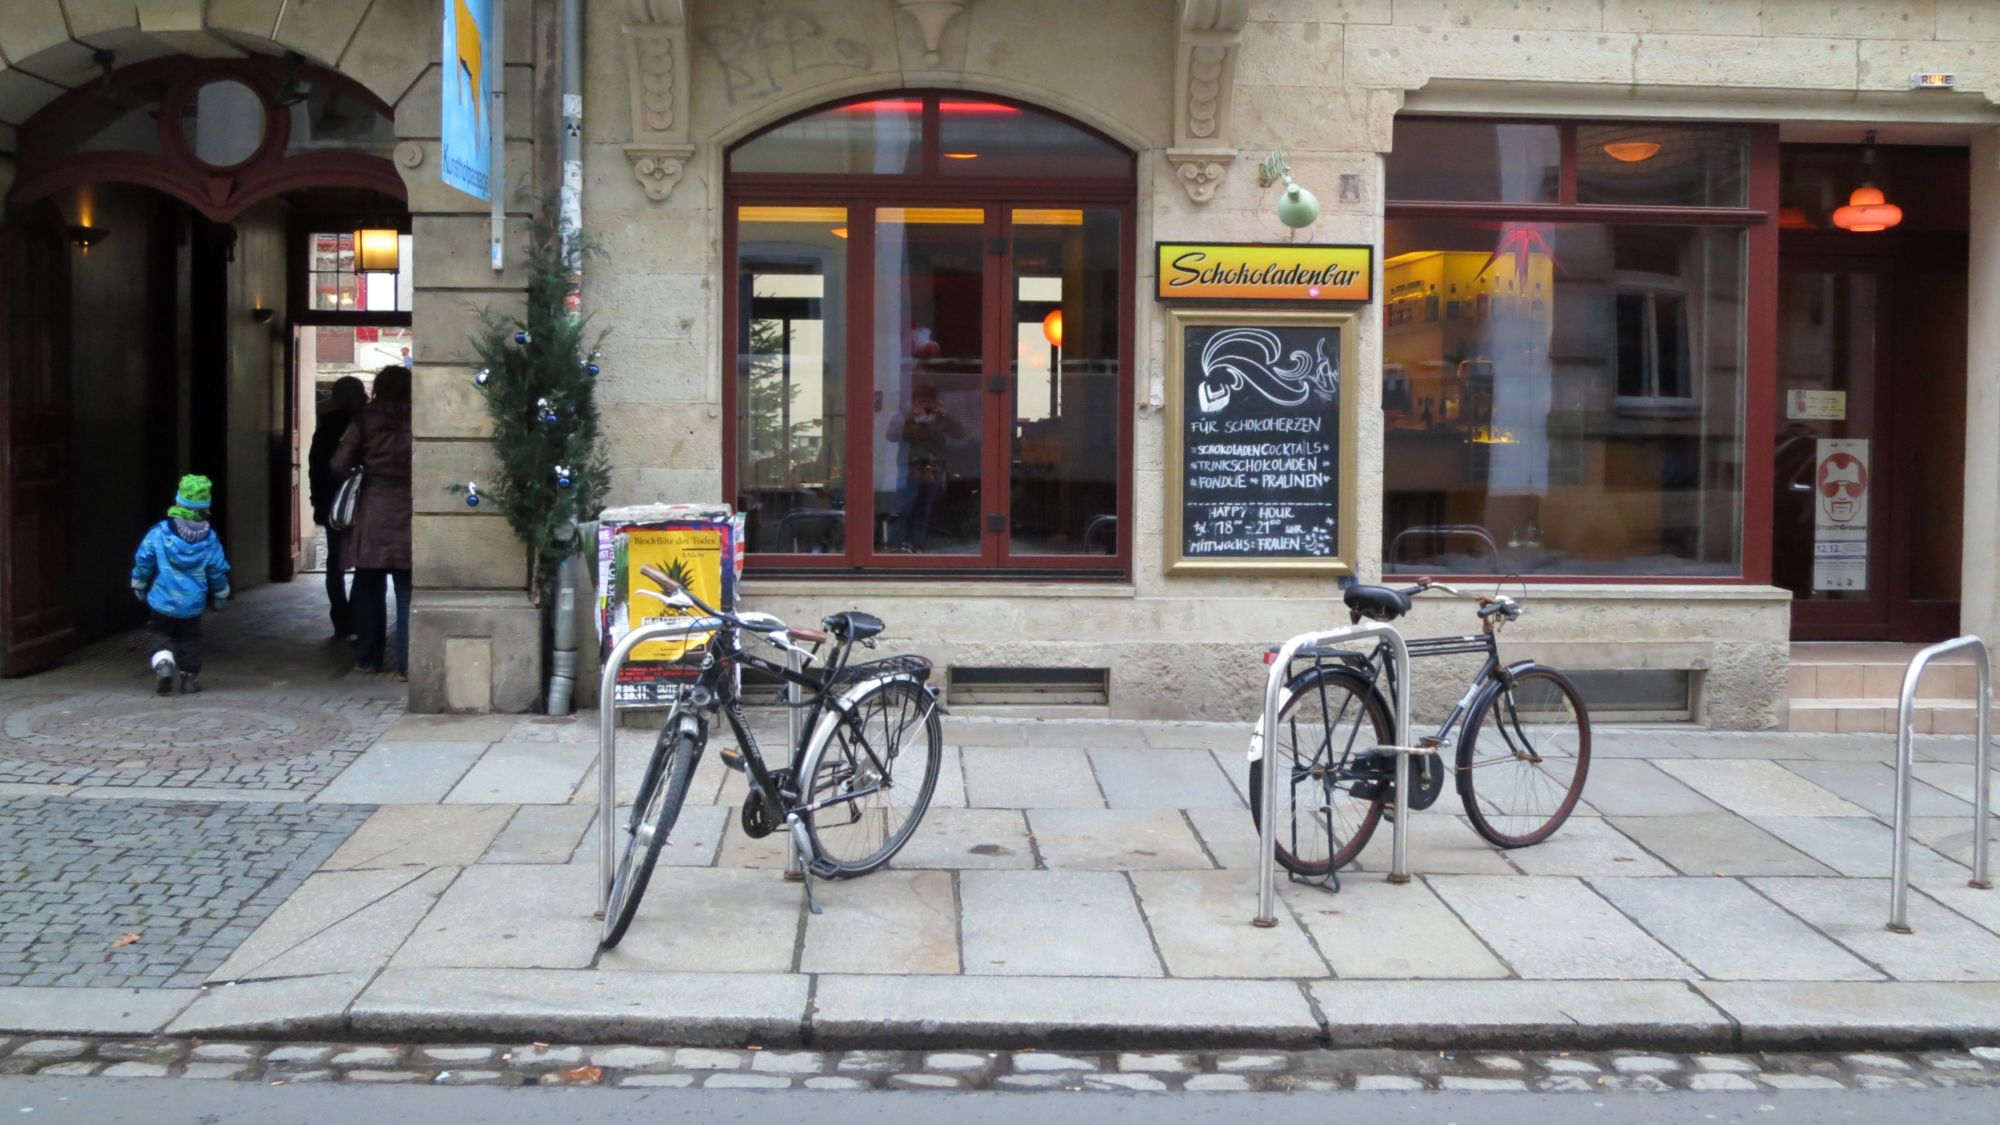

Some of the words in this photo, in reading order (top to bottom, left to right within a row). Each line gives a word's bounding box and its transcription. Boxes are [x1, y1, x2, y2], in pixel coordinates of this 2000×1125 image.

[1169, 252, 1359, 286] Schokoladenbar
[1224, 417, 1321, 433] SCHOKOHERZEN
[1198, 457, 1317, 472] TRINKSCHOKOLADEN
[1199, 474, 1247, 489] FONDUE
[1262, 473, 1323, 489] PRALINEN
[1209, 506, 1246, 519] HAPPY
[1259, 507, 1295, 519] HOUR
